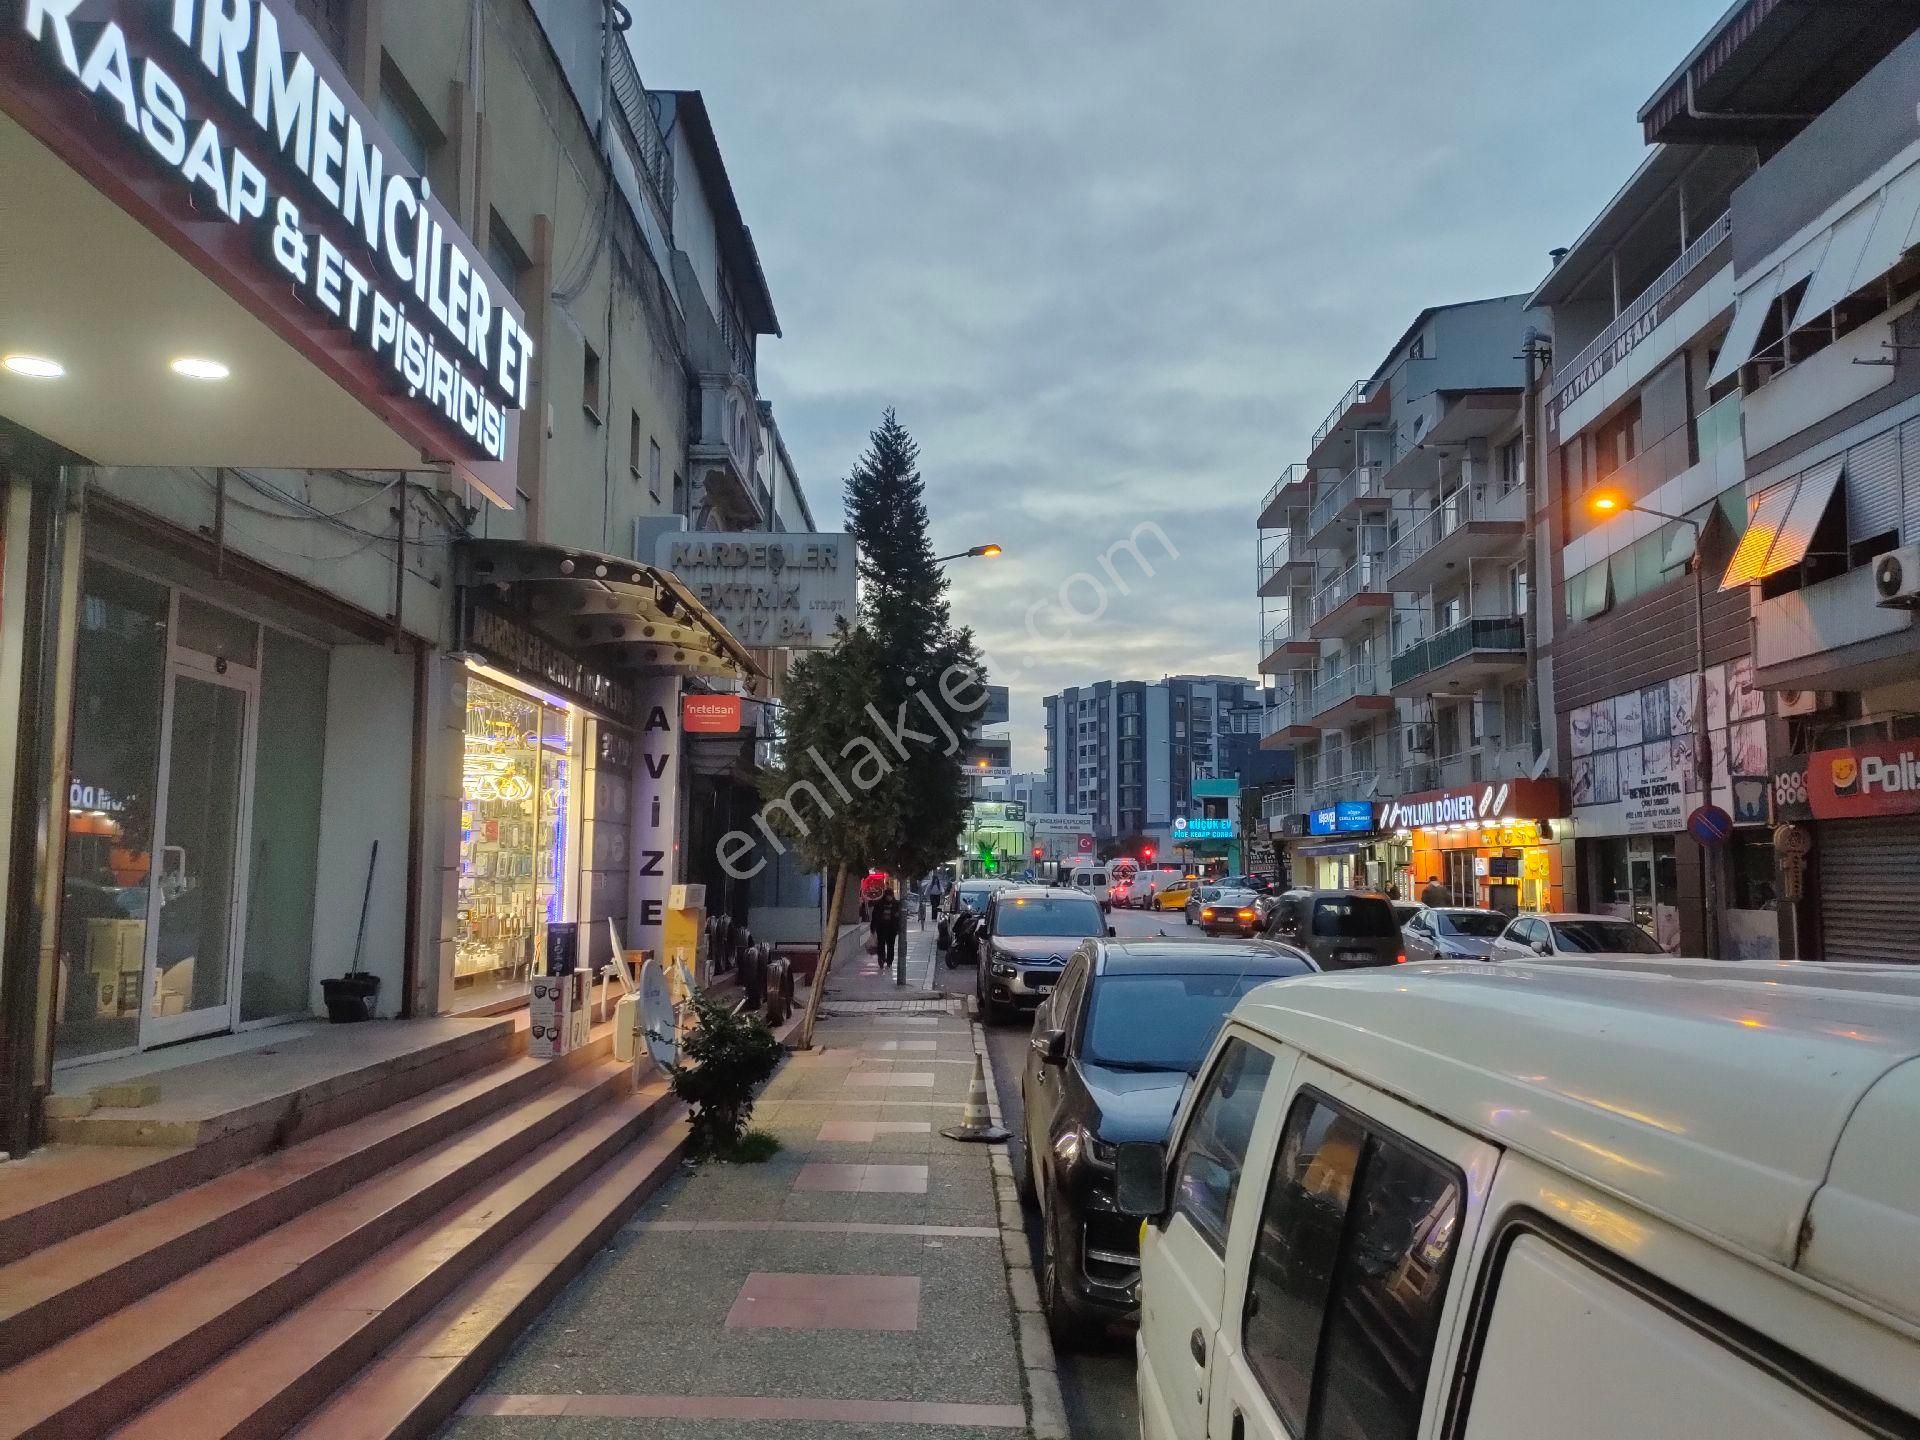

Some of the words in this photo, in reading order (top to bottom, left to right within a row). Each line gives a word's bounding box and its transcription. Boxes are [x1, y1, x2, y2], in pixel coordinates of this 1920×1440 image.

[272, 196, 308, 285] &
[315, 233, 369, 333] ET
[371, 288, 507, 463] PİŞİRİCİSİ
[499, 306, 534, 411] ET
[671, 542, 839, 576] KARDEŞLER
[737, 615, 769, 640] 17
[780, 615, 813, 640] 84
[689, 704, 735, 714] netelsan
[639, 705, 671, 926] AVİZE
[1189, 819, 1219, 831] KÜÇÜK
[1221, 820, 1233, 830] EV
[1401, 802, 1434, 827] OYLUM
[1436, 793, 1475, 823] DÖNER
[1174, 830, 1189, 838] PİDE
